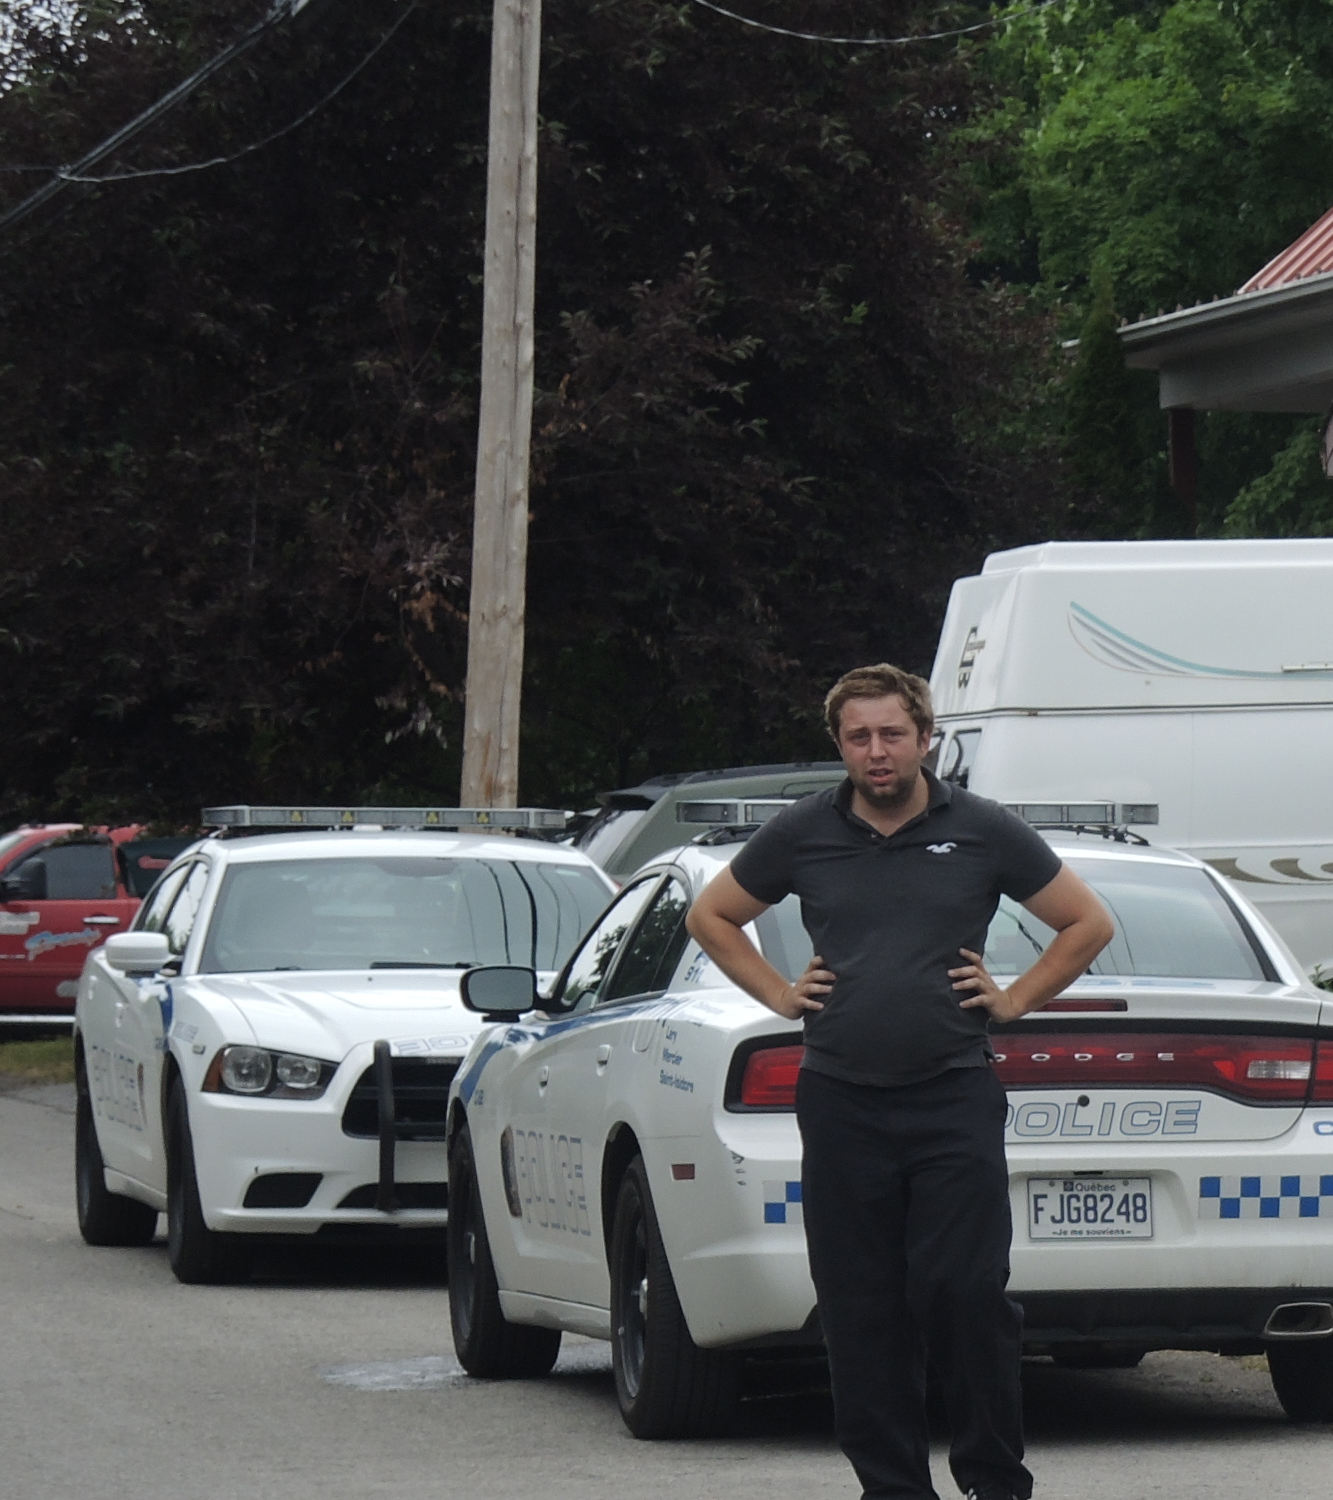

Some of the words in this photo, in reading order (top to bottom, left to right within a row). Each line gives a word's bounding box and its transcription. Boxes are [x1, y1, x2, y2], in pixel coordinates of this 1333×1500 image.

[1005, 1100, 1202, 1137] OLICE
[516, 1129, 591, 1237] POLICE
[1075, 1182, 1117, 1192] Québec
[1033, 1193, 1148, 1224] FJG8248
